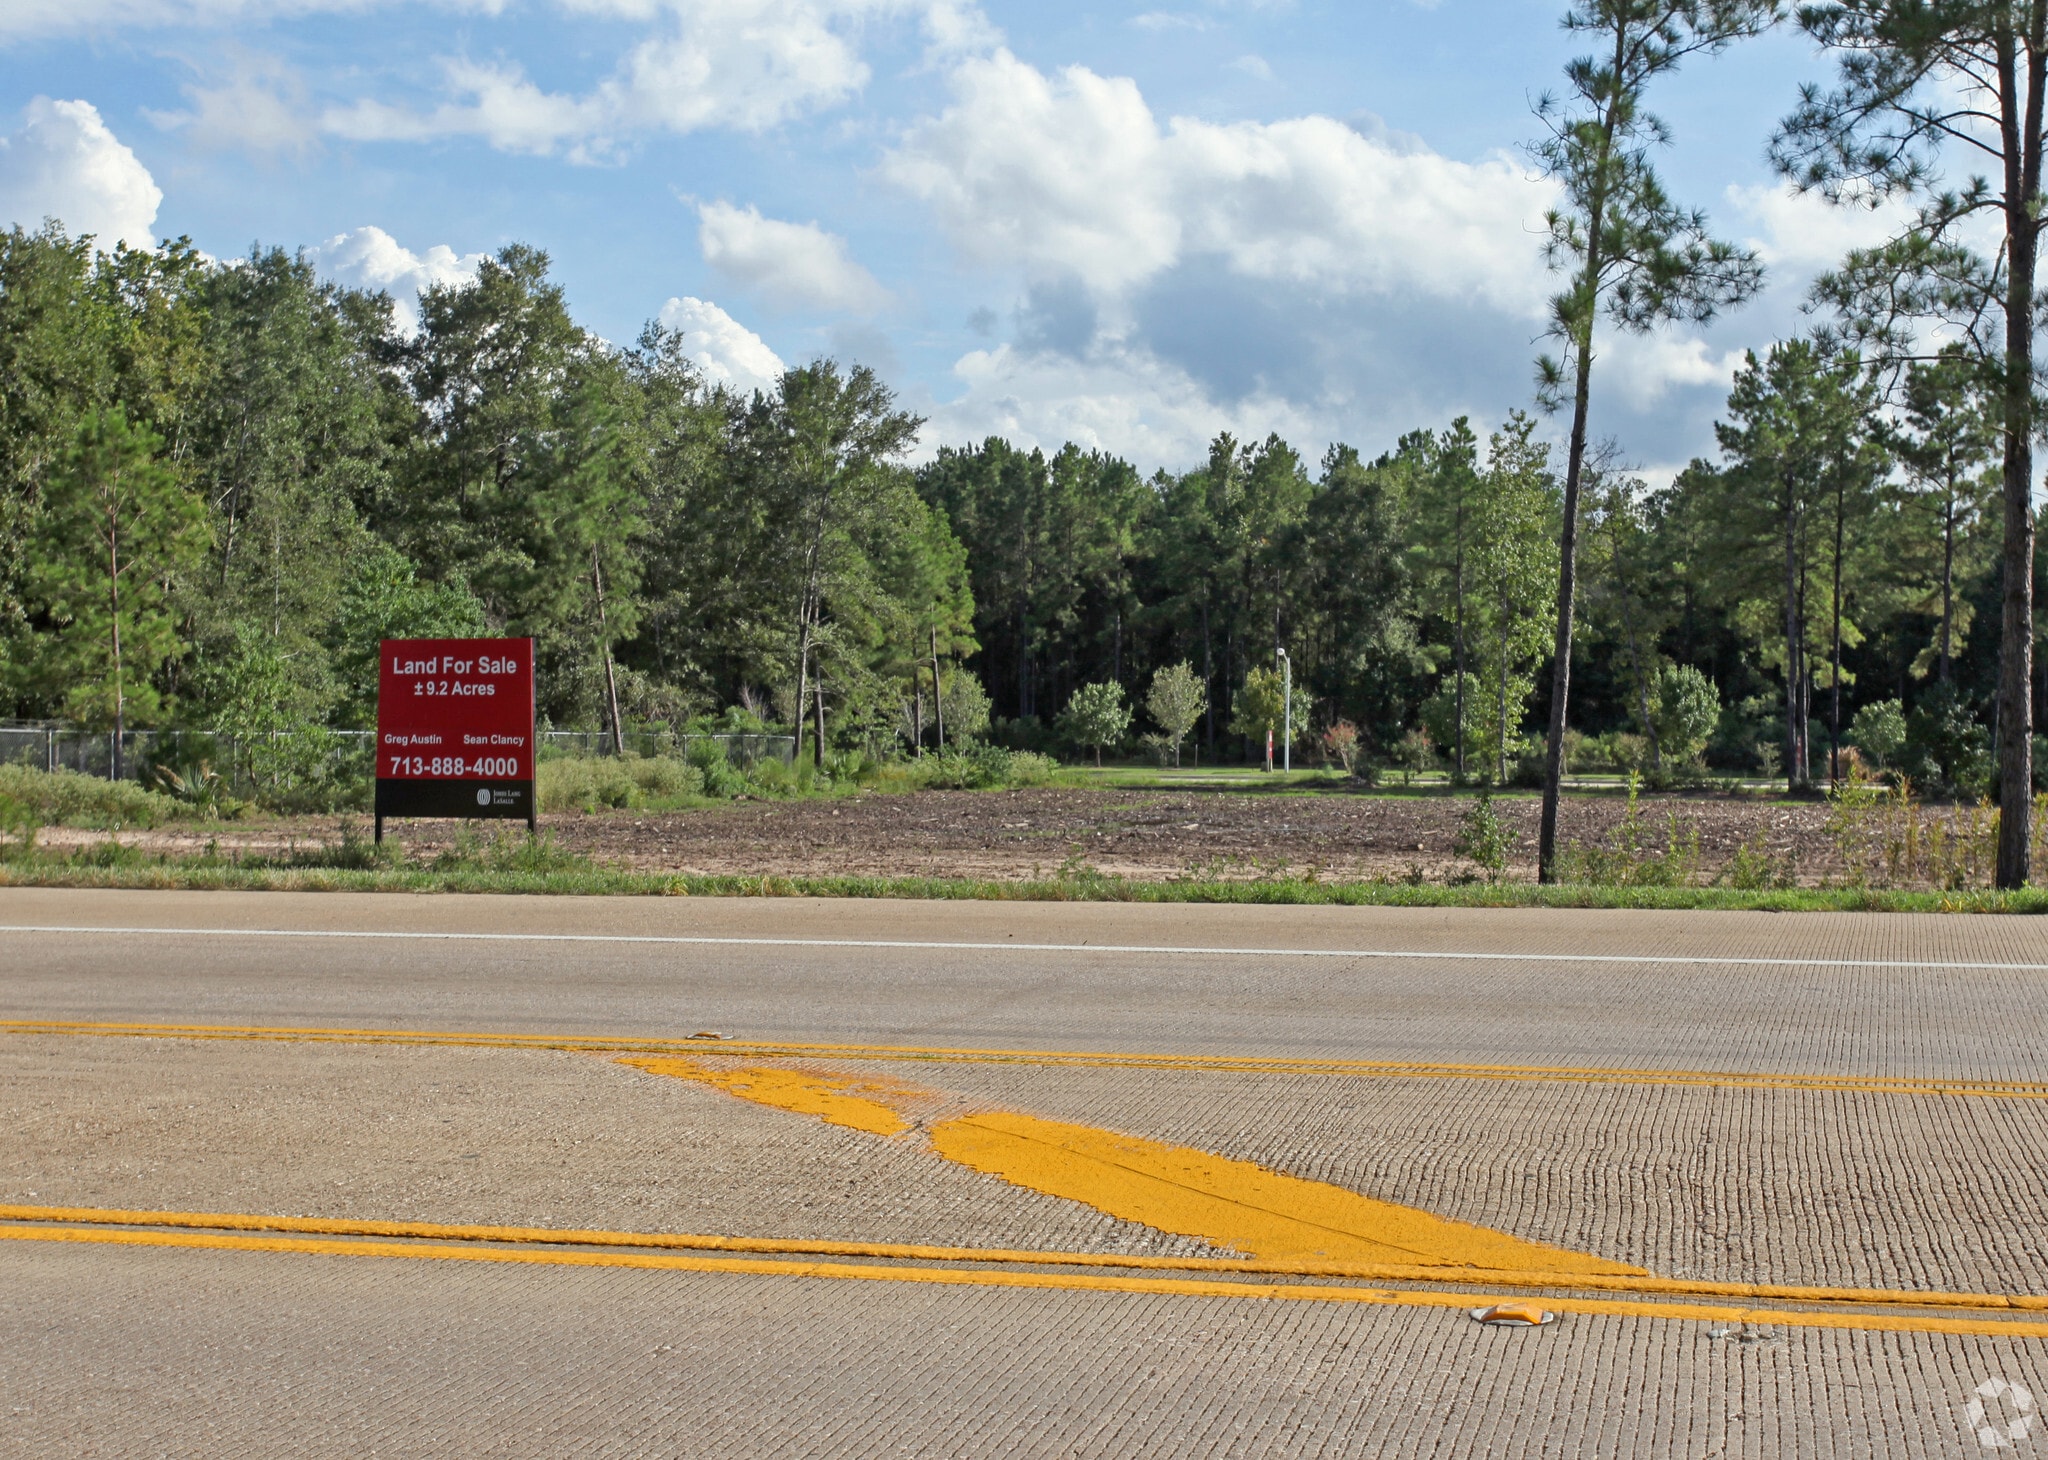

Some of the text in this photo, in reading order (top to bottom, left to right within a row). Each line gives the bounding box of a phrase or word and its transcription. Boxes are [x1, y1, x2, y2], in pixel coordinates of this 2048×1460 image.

[393, 656, 517, 674] Land For Sale
[451, 681, 495, 696] Acres
[384, 734, 442, 746] Greg Austin
[463, 734, 525, 747] Sean Clancy
[390, 757, 518, 776] 713-888-4000
